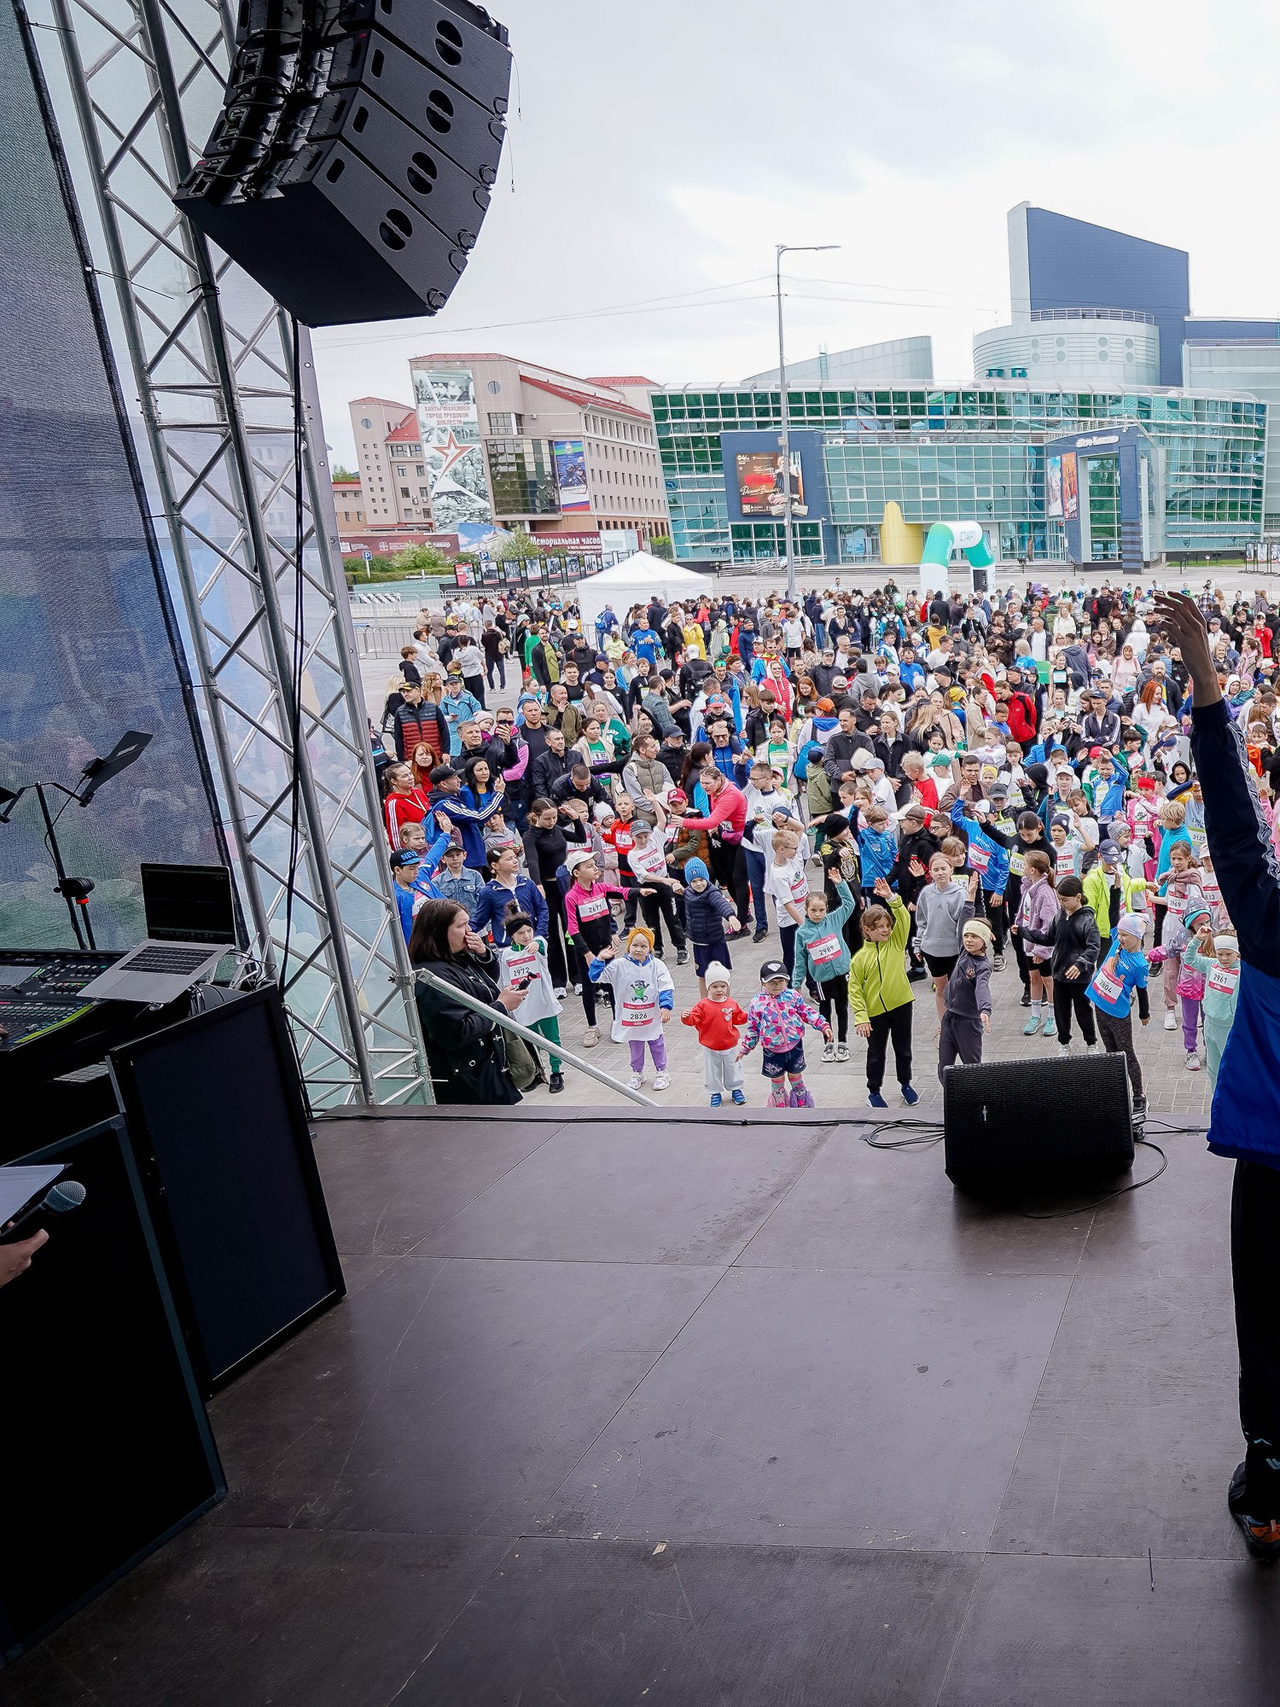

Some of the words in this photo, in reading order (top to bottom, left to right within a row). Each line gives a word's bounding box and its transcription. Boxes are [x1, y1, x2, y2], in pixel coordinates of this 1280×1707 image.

[513, 967, 530, 977] 2972
[1213, 973, 1228, 983] 2961
[630, 1012, 648, 1021] 2826
